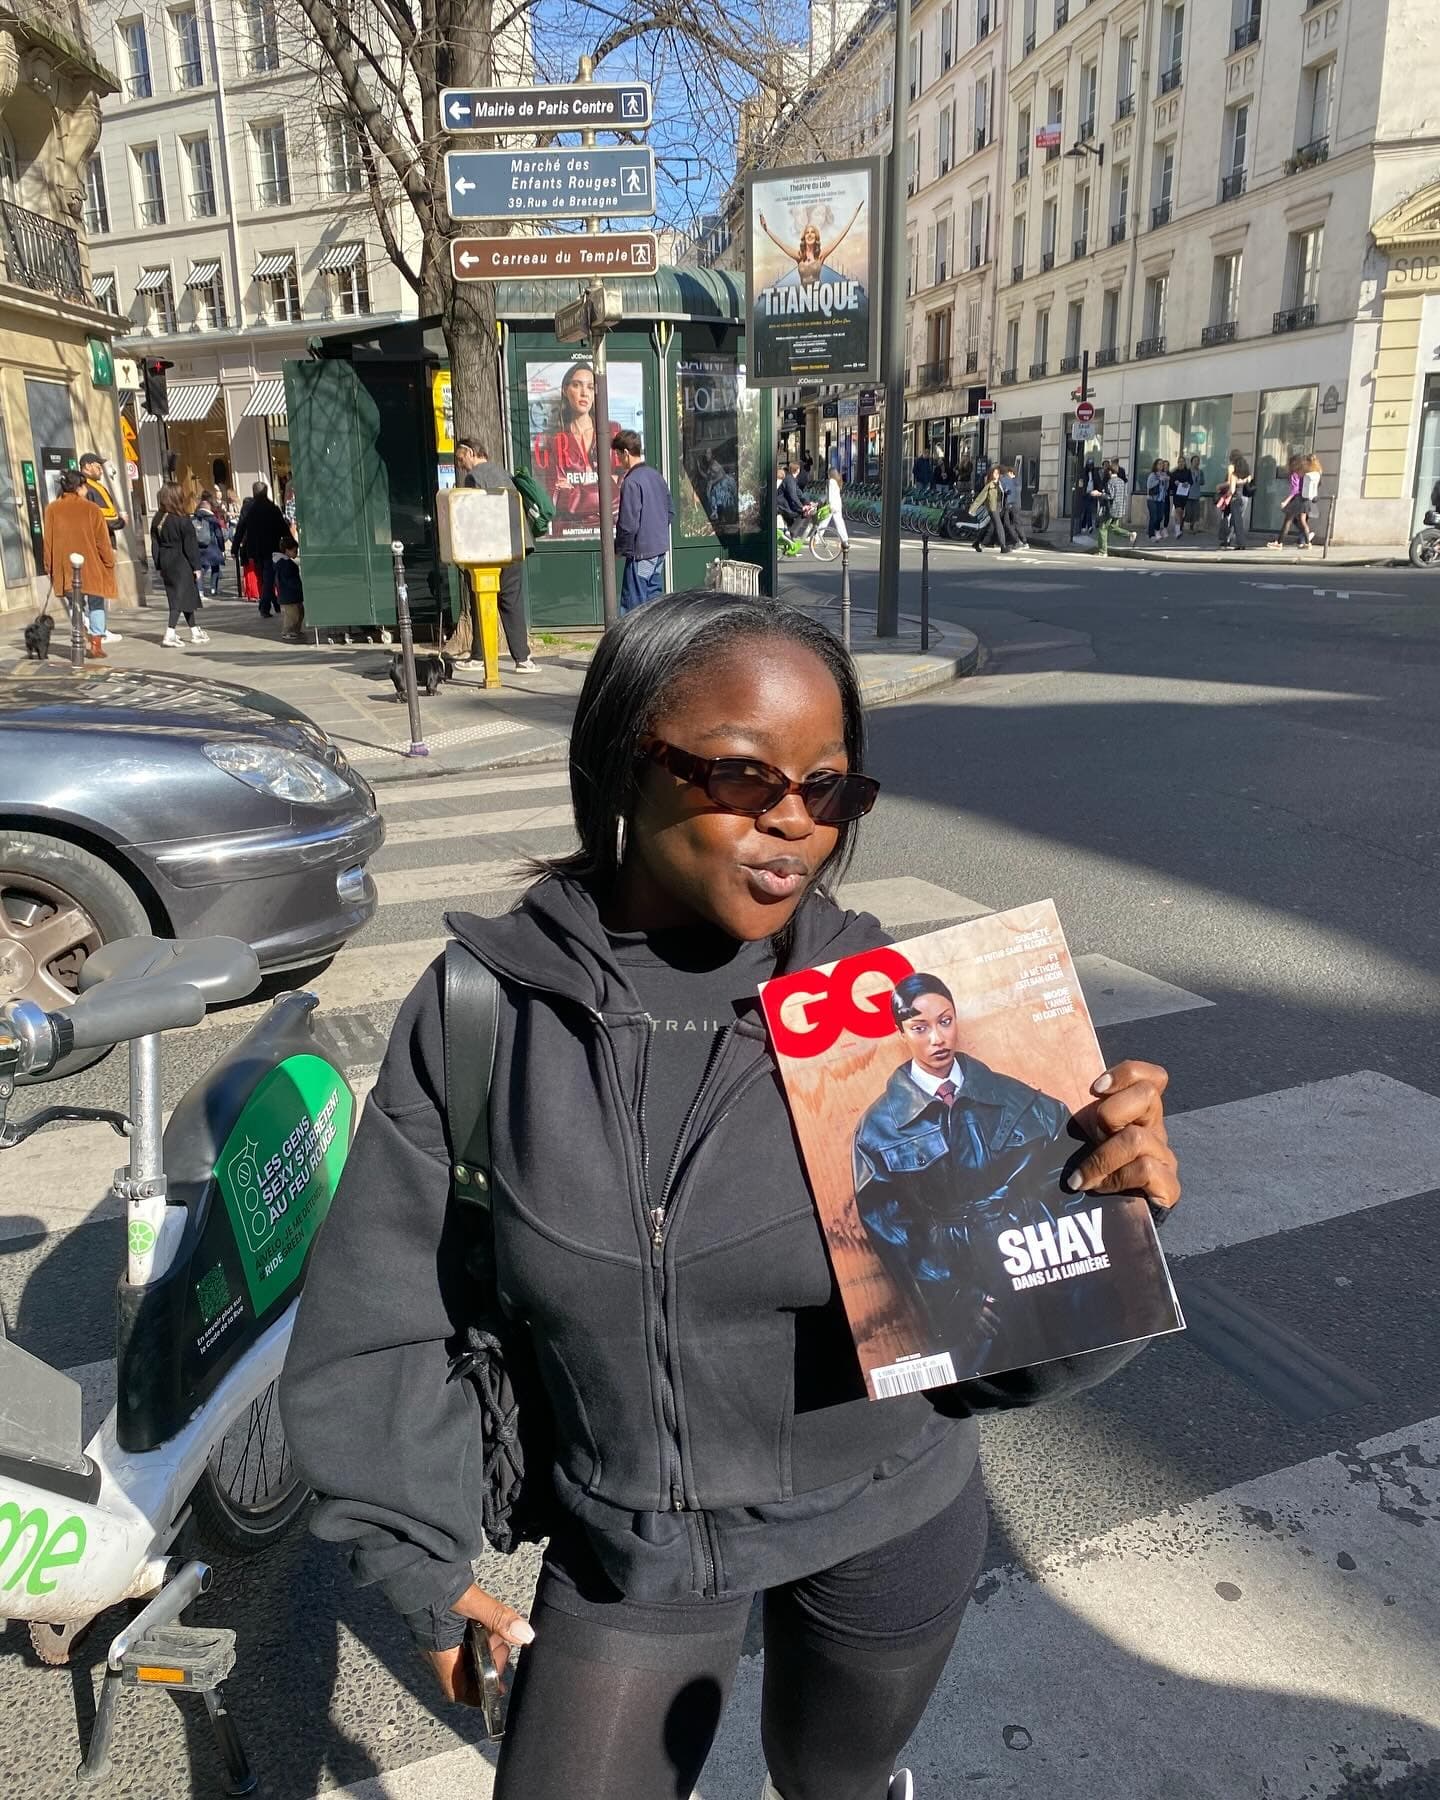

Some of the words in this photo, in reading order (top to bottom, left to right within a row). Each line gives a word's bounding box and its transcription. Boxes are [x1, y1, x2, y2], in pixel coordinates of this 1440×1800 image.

[475, 101, 515, 118] Mairie
[518, 101, 534, 116] de
[537, 99, 569, 115] Paris
[572, 98, 614, 114] Centre
[511, 158, 560, 173] Marché
[567, 158, 590, 171] des
[511, 177, 562, 190] Enfants
[568, 176, 617, 193] Rouges
[552, 196, 565, 207] de
[569, 195, 618, 210] Bretagne
[491, 252, 547, 266] Carreau
[555, 251, 571, 264] du
[579, 249, 628, 266] Temple
[256, 1153, 282, 1188] LES
[282, 1115, 310, 1158] GENS
[262, 1160, 294, 1206] SEXY
[268, 1194, 288, 1225] AU
[288, 1165, 310, 1201] FEU
[309, 1120, 337, 1172] ROUGE
[997, 1207, 1106, 1276] SHAY
[1011, 1271, 1046, 1291] DANS
[1044, 1267, 1062, 1283] LA
[1061, 1254, 1111, 1279] LUMIÈRE
[197, 1336, 205, 1346] En
[221, 1305, 234, 1322] plus
[205, 1330, 221, 1348] Code
[220, 1322, 228, 1333] de
[227, 1316, 234, 1325] la
[0, 1501, 87, 1596] me
